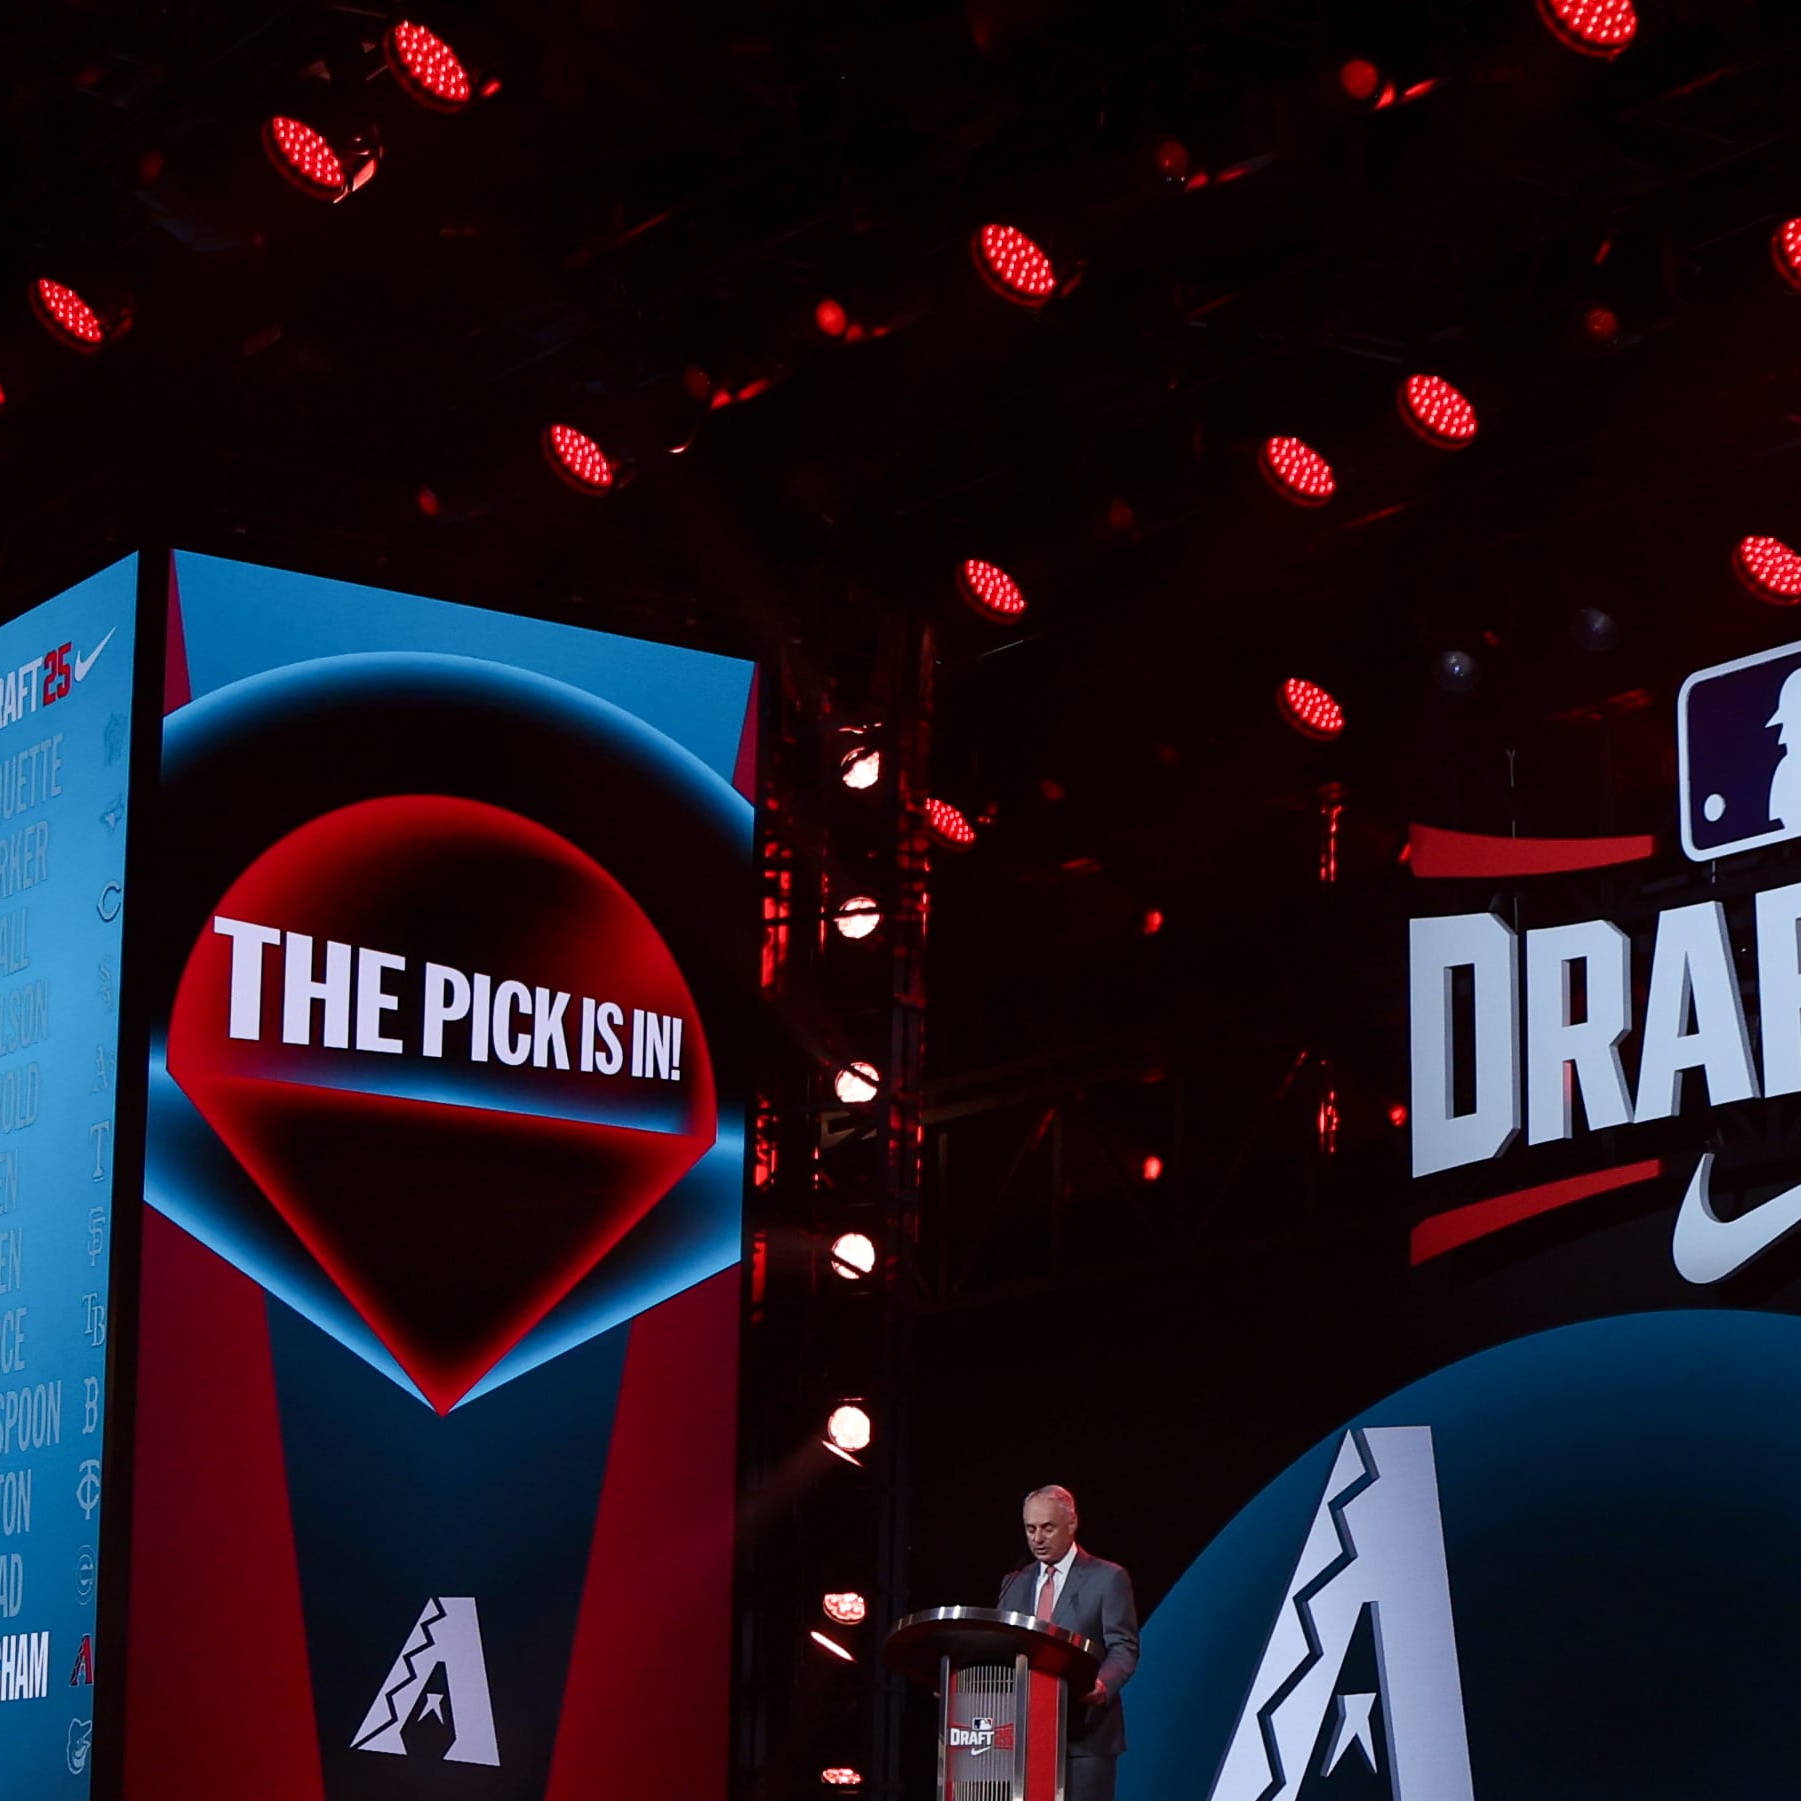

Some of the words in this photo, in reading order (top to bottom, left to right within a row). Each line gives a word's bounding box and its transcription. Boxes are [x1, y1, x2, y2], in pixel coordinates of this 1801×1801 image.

[43, 641, 73, 708] 25
[213, 915, 407, 1055] THE
[422, 961, 572, 1071] PICK
[580, 996, 625, 1076] IS
[631, 1008, 684, 1082] IN!
[950, 1727, 995, 1746] DRAFT
